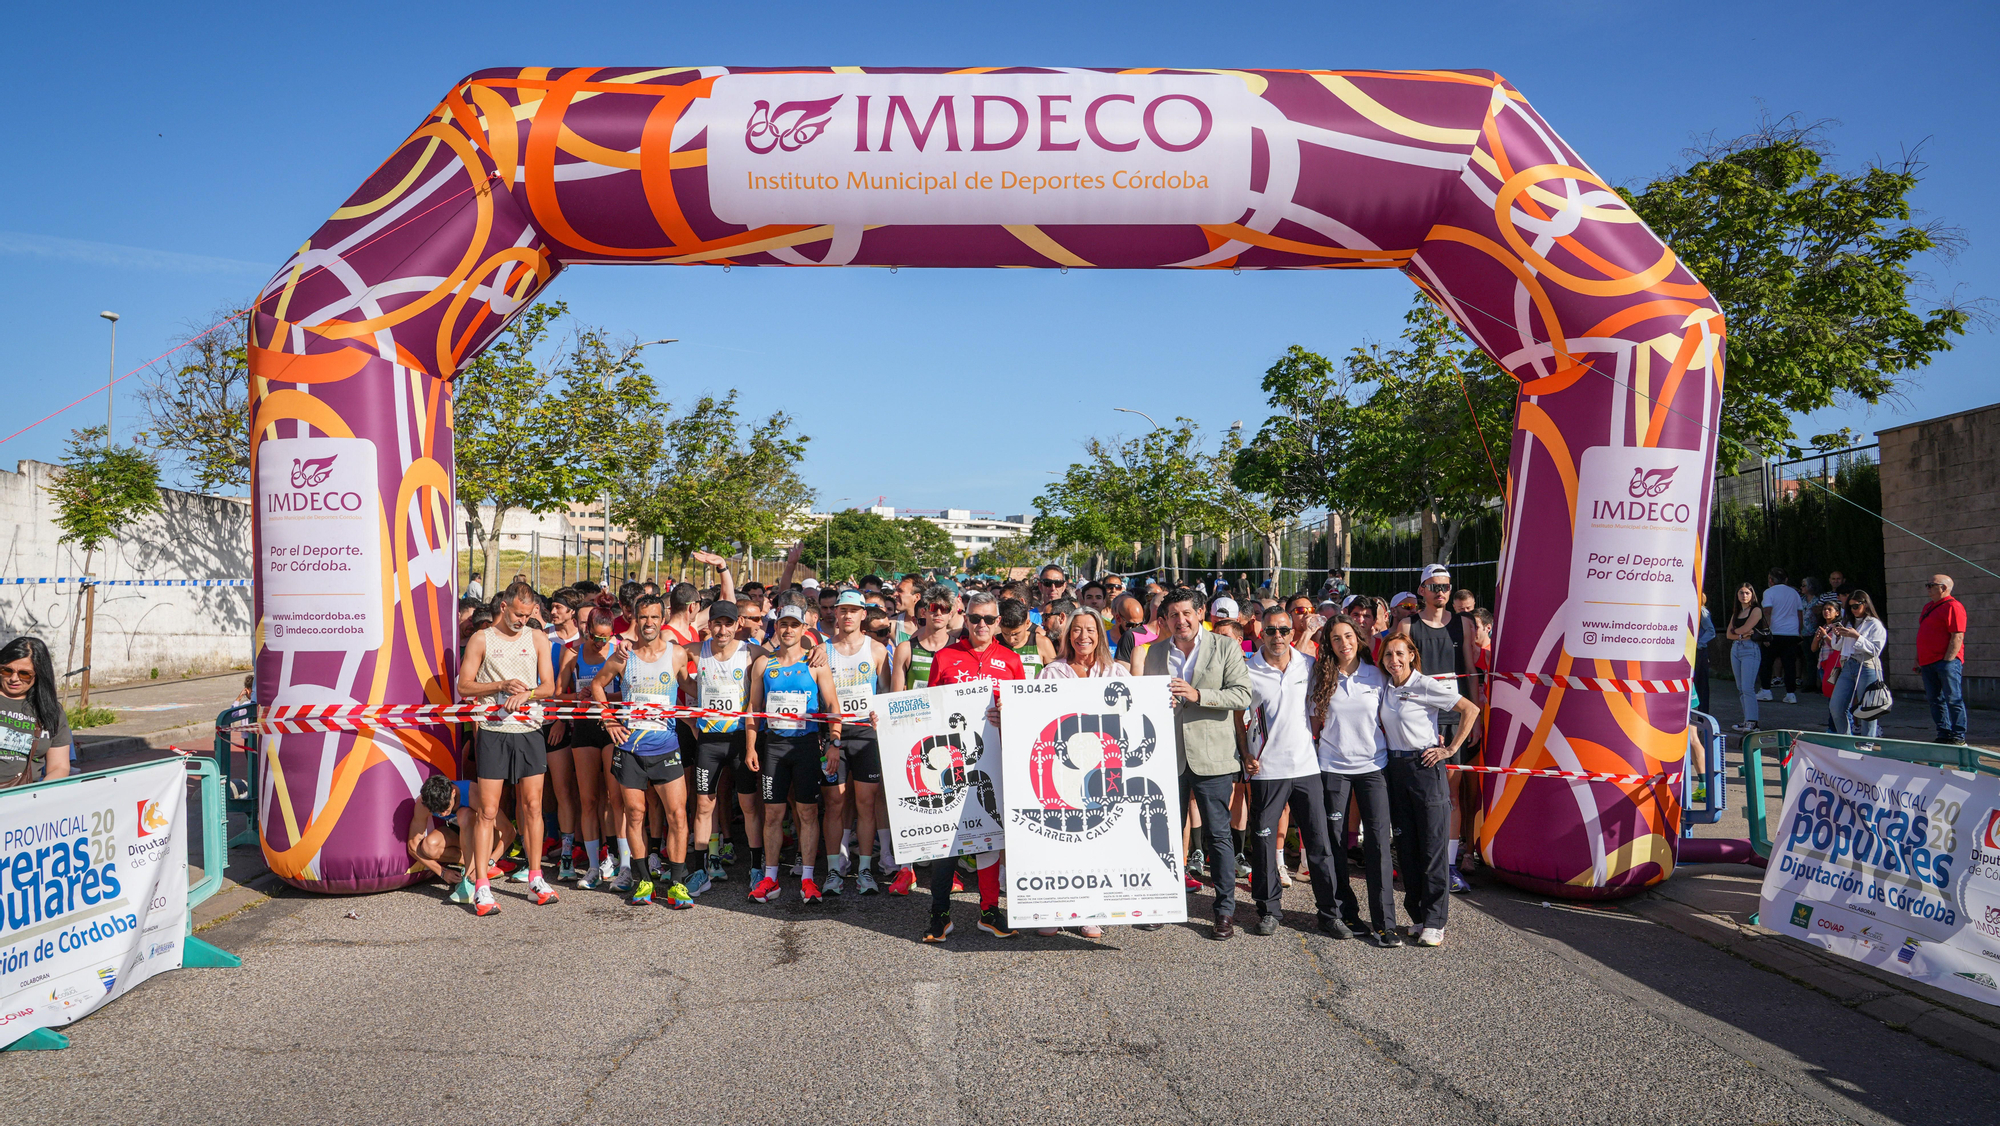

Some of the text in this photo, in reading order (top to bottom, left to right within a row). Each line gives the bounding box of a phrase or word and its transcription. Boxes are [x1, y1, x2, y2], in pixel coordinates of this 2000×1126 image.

[853, 94, 1213, 153] IMDECO
[747, 169, 1209, 194] Instituto Municipal de Deportes Córdoba
[268, 491, 362, 513] IMDECO
[1592, 500, 1690, 524] IMDECO
[270, 544, 363, 558] Por el Deporte.
[270, 560, 351, 572] Por Córdoba.
[1588, 552, 1684, 568] Por el Deporte.
[1586, 568, 1674, 582] Por Córdoba.
[272, 612, 366, 621] www.imdcordoba.es
[286, 626, 364, 634] imdeco.cordoba
[1582, 620, 1678, 632] www.imdcordoba.es
[1602, 633, 1675, 645] imdeco.cordoba
[1012, 684, 1058, 694] 19.04.26
[709, 700, 733, 711] 530
[843, 698, 868, 712] 505
[888, 697, 922, 708] carreras
[889, 702, 930, 716] populares
[909, 804, 943, 815] CARRERA
[945, 789, 968, 812] CALIFAS
[1854, 781, 1927, 812] PROVINCIAL
[1931, 798, 1961, 827] 20
[1011, 805, 1124, 843] 37 CARRERA CALIFAS
[1799, 786, 1957, 853] carreras 26
[5, 808, 114, 851] PROVINCIAL 20
[900, 822, 959, 838] CORDOBA
[962, 818, 983, 829] 10K
[91, 835, 116, 865] 26
[1786, 812, 1953, 888] populares
[130, 858, 147, 869] de
[1968, 864, 1981, 877] de
[1016, 873, 1152, 891] CORDOBA 10K
[1780, 854, 1956, 926] Diputación de Córdoba
[1848, 904, 1876, 916] COLABORAN
[1818, 918, 1844, 933] COVAP
[34, 938, 54, 964] de
[58, 913, 137, 954] Córdoba
[20, 973, 50, 987] COLABORAN
